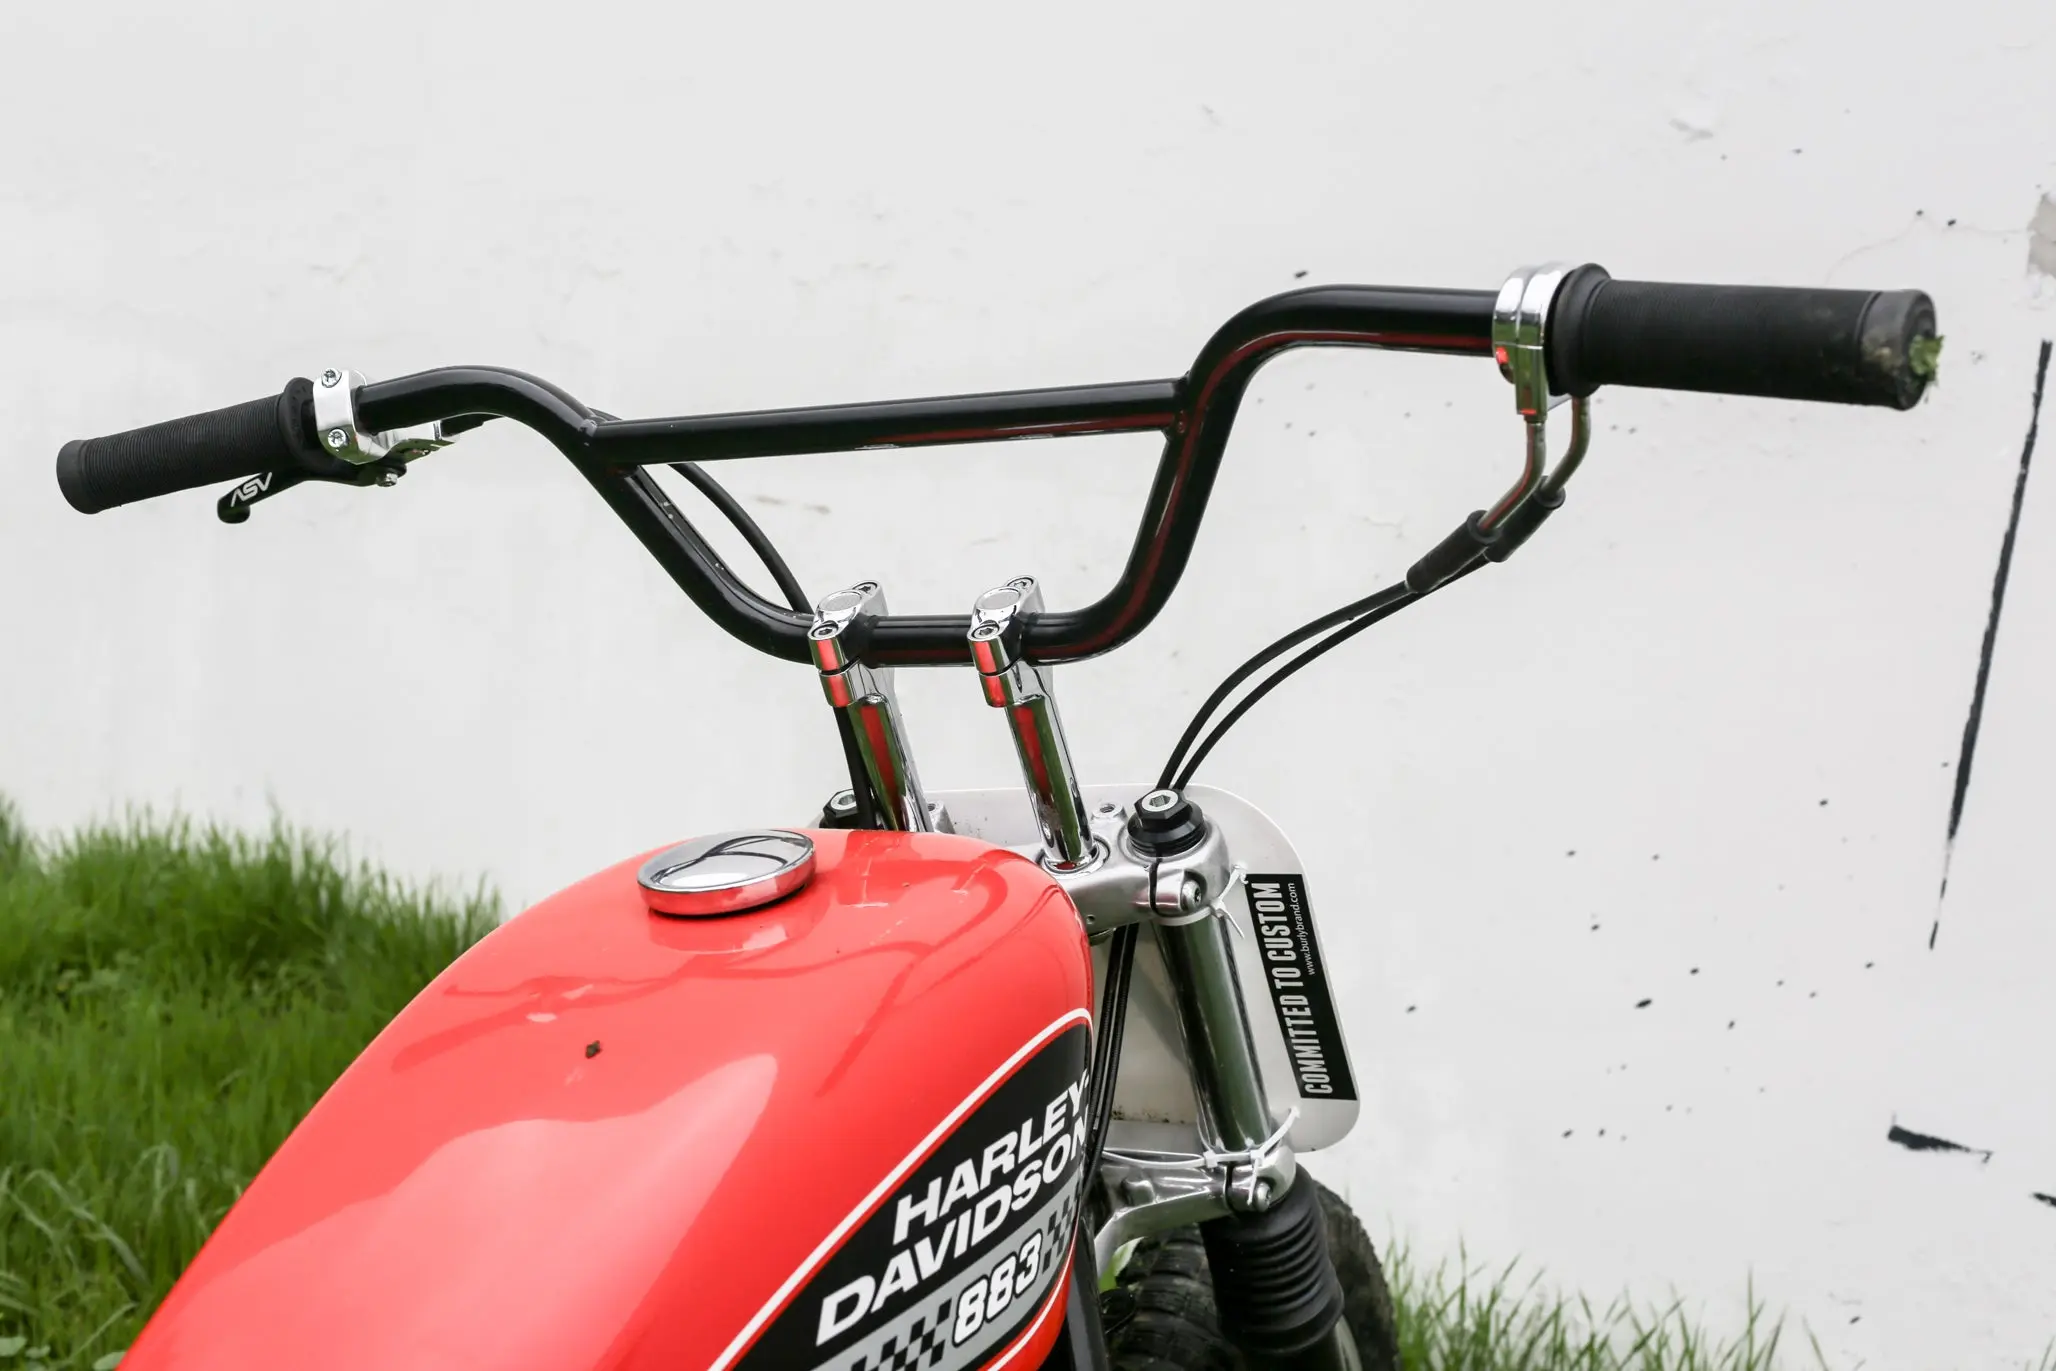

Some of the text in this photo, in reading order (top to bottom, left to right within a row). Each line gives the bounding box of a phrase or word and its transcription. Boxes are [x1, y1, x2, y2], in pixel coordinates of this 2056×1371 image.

[231, 472, 272, 507] ASV
[1287, 882, 1315, 975] www.burlybrand.com
[1251, 883, 1333, 1094] COMMITTED TO CUSTOM
[953, 1232, 1042, 1346] 883
